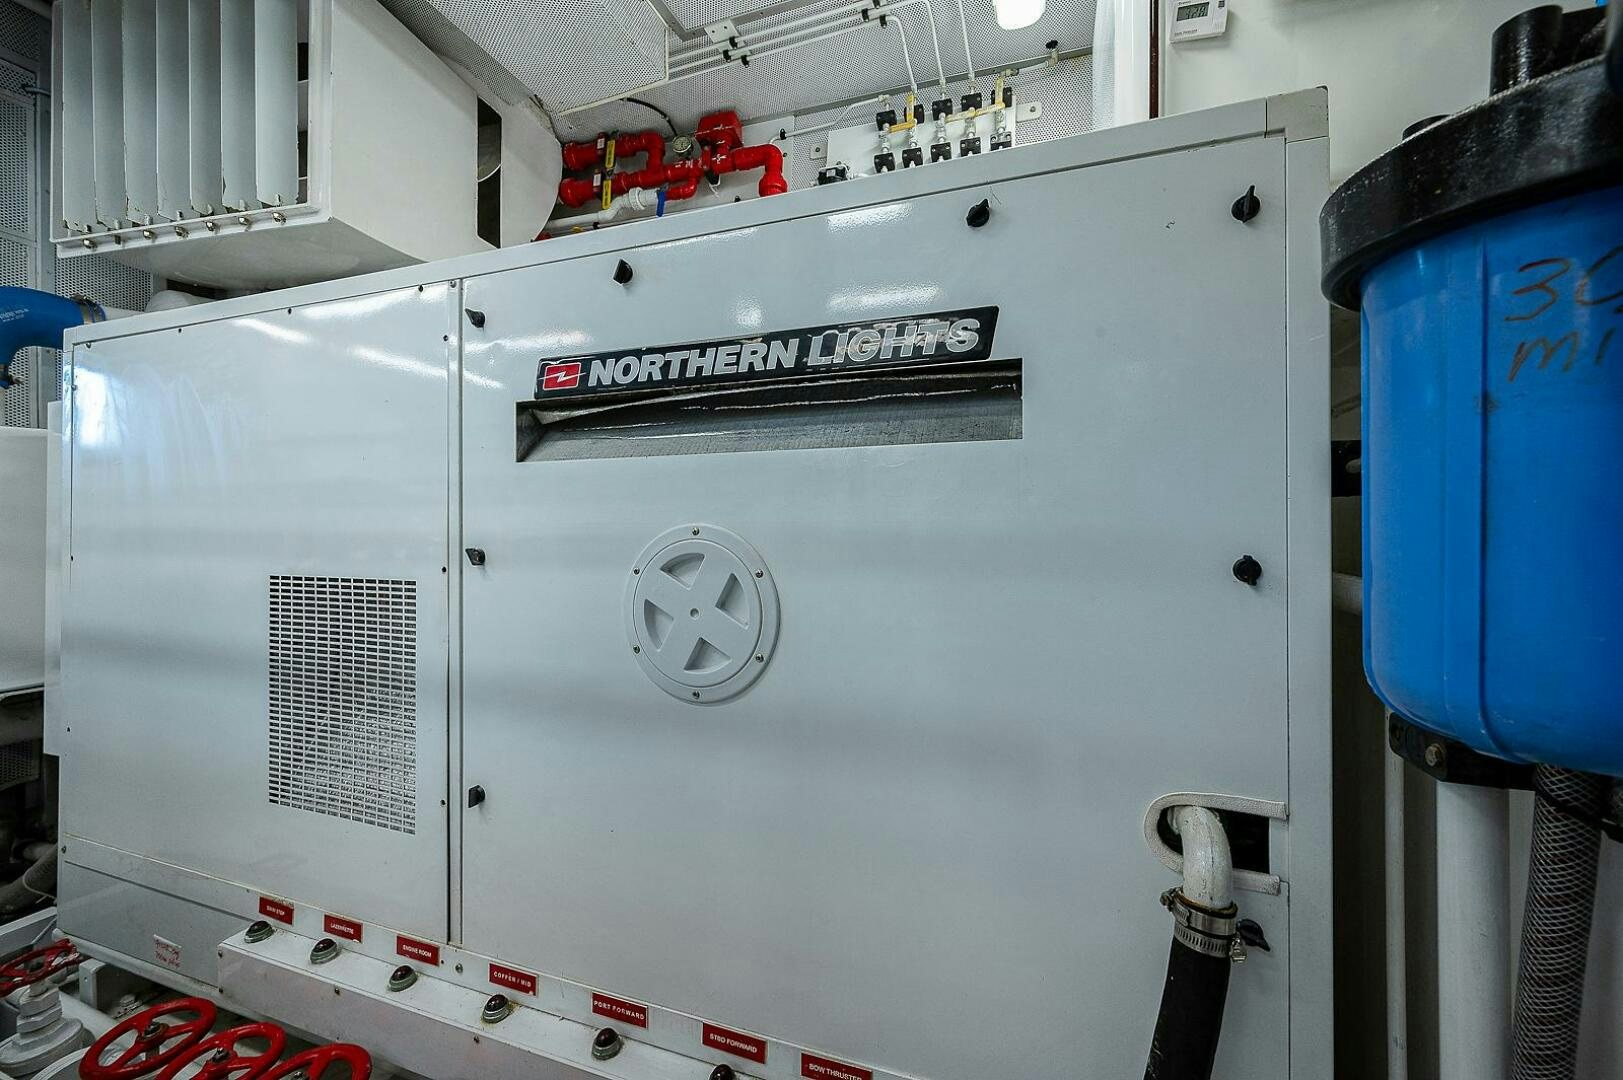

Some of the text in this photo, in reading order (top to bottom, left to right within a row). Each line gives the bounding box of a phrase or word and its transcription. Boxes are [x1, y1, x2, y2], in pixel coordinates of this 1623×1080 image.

[587, 317, 980, 387] NORTHERN LIGHTS
[402, 944, 432, 958] ENGINE ROOM
[593, 1000, 645, 1020] PORT FORWARD
[726, 1037, 758, 1054] FORWARD
[808, 1063, 826, 1074] BOW
